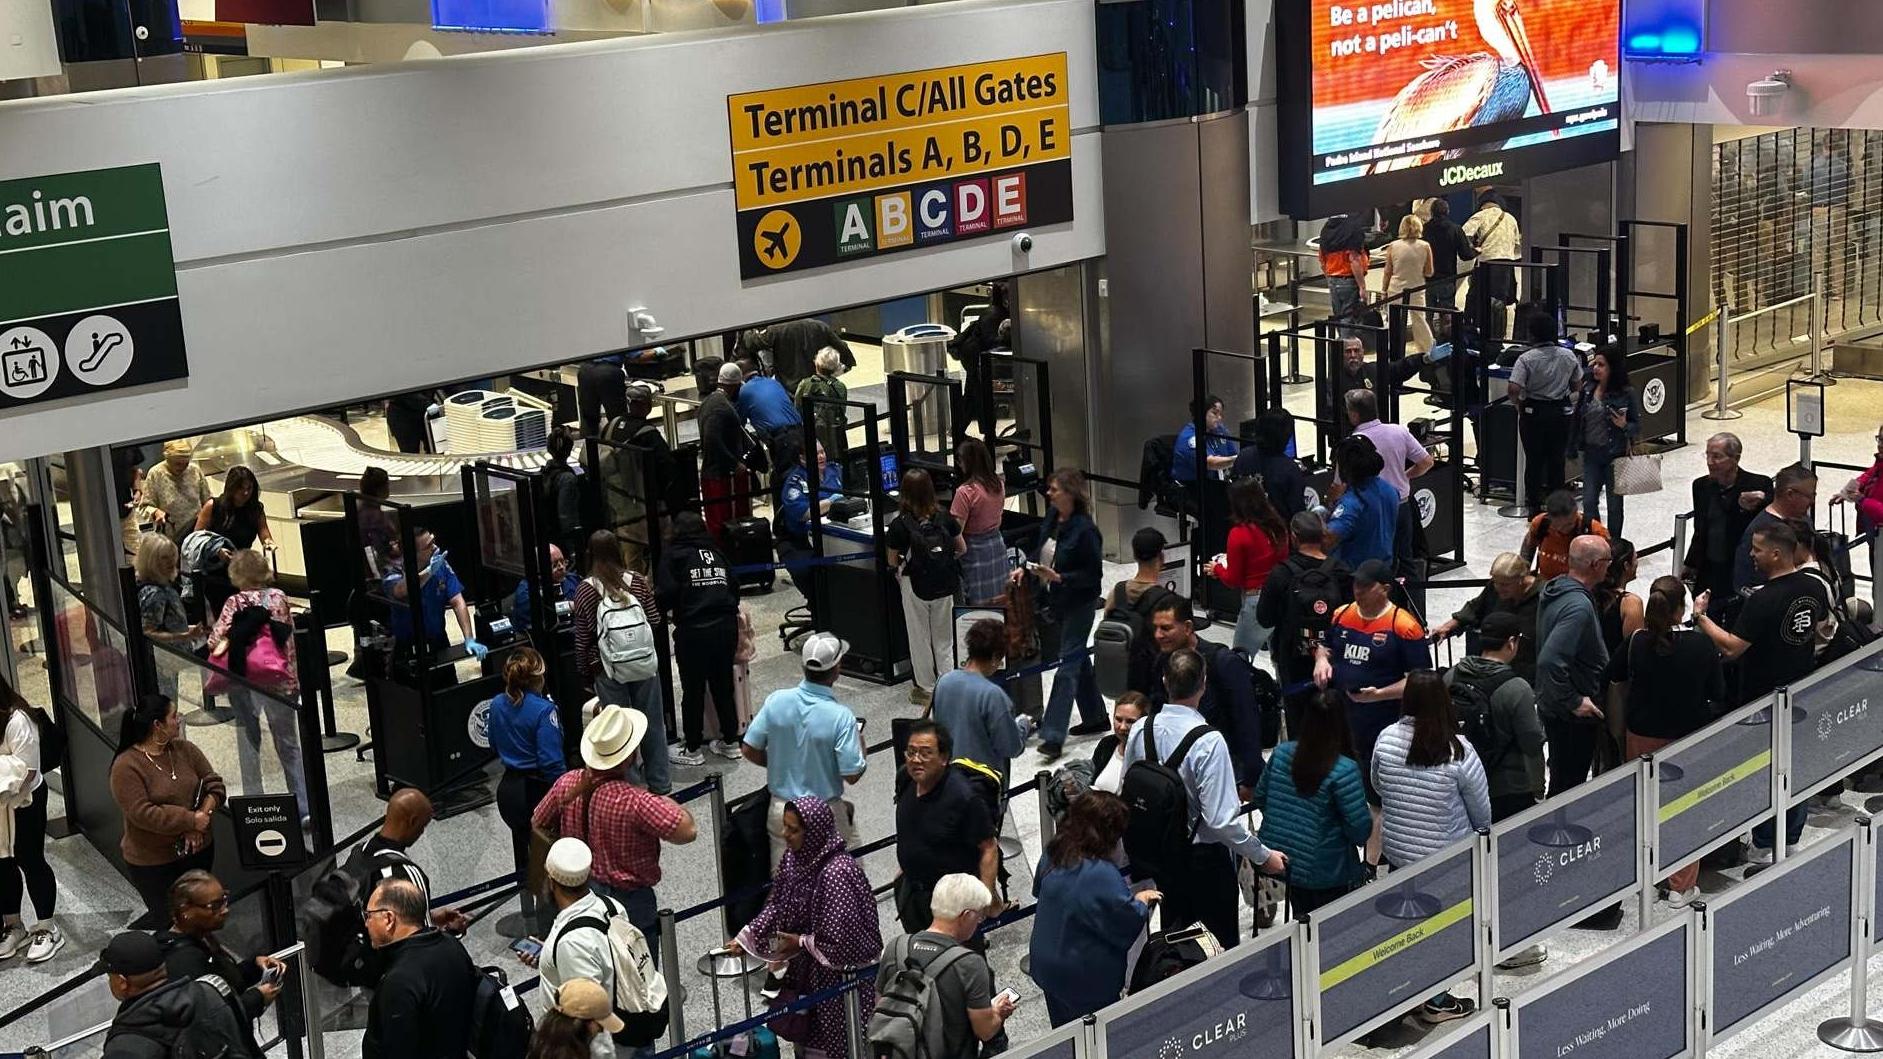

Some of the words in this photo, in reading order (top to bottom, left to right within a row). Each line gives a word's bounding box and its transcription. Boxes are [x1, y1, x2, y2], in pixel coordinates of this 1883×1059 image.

[1330, 5, 1353, 27] Be
[1356, 6, 1368, 23] a
[1371, 0, 1437, 26] pelican,
[1331, 34, 1362, 57] not
[1365, 35, 1376, 52] a
[1380, 19, 1458, 55] peli-can't
[744, 86, 888, 138] Terminal
[895, 76, 966, 118] C/All
[974, 72, 1057, 106] Gates
[749, 141, 912, 195] Terminals
[922, 137, 953, 171] A,
[963, 131, 991, 166] B,
[1000, 124, 1030, 159] D,
[1040, 118, 1056, 151] E
[1439, 161, 1504, 187] JCDecaux
[0, 189, 95, 237] aim
[840, 203, 870, 244] A
[881, 196, 908, 235] B
[920, 189, 947, 228] C
[958, 184, 985, 222] D
[997, 177, 1021, 216] E
[840, 242, 870, 253] TERMINAL
[881, 235, 911, 246] TERMINAL
[920, 229, 950, 239] TERMINAL
[959, 221, 988, 232] TERMINAL
[996, 215, 1025, 225] TERMINAL
[1343, 643, 1370, 661] KUB
[1836, 699, 1868, 724] CLEAR
[244, 816, 263, 824] Solo
[264, 815, 287, 823] salida
[248, 806, 263, 814] Exit
[263, 805, 281, 813] only
[1560, 836, 1601, 866] CLEAR
[1372, 938, 1405, 960] Welcome
[1406, 927, 1424, 944] Back
[1733, 951, 1749, 966] Less
[1776, 927, 1793, 940] More
[1794, 905, 1831, 931] Adventuring
[1192, 1012, 1246, 1050] CLEAR
[1229, 1028, 1247, 1042] PLUS
[1557, 1042, 1574, 1058] Less
[1575, 1025, 1607, 1047] Waiting,
[1607, 1014, 1627, 1032] More
[1628, 1001, 1651, 1020] Doing
